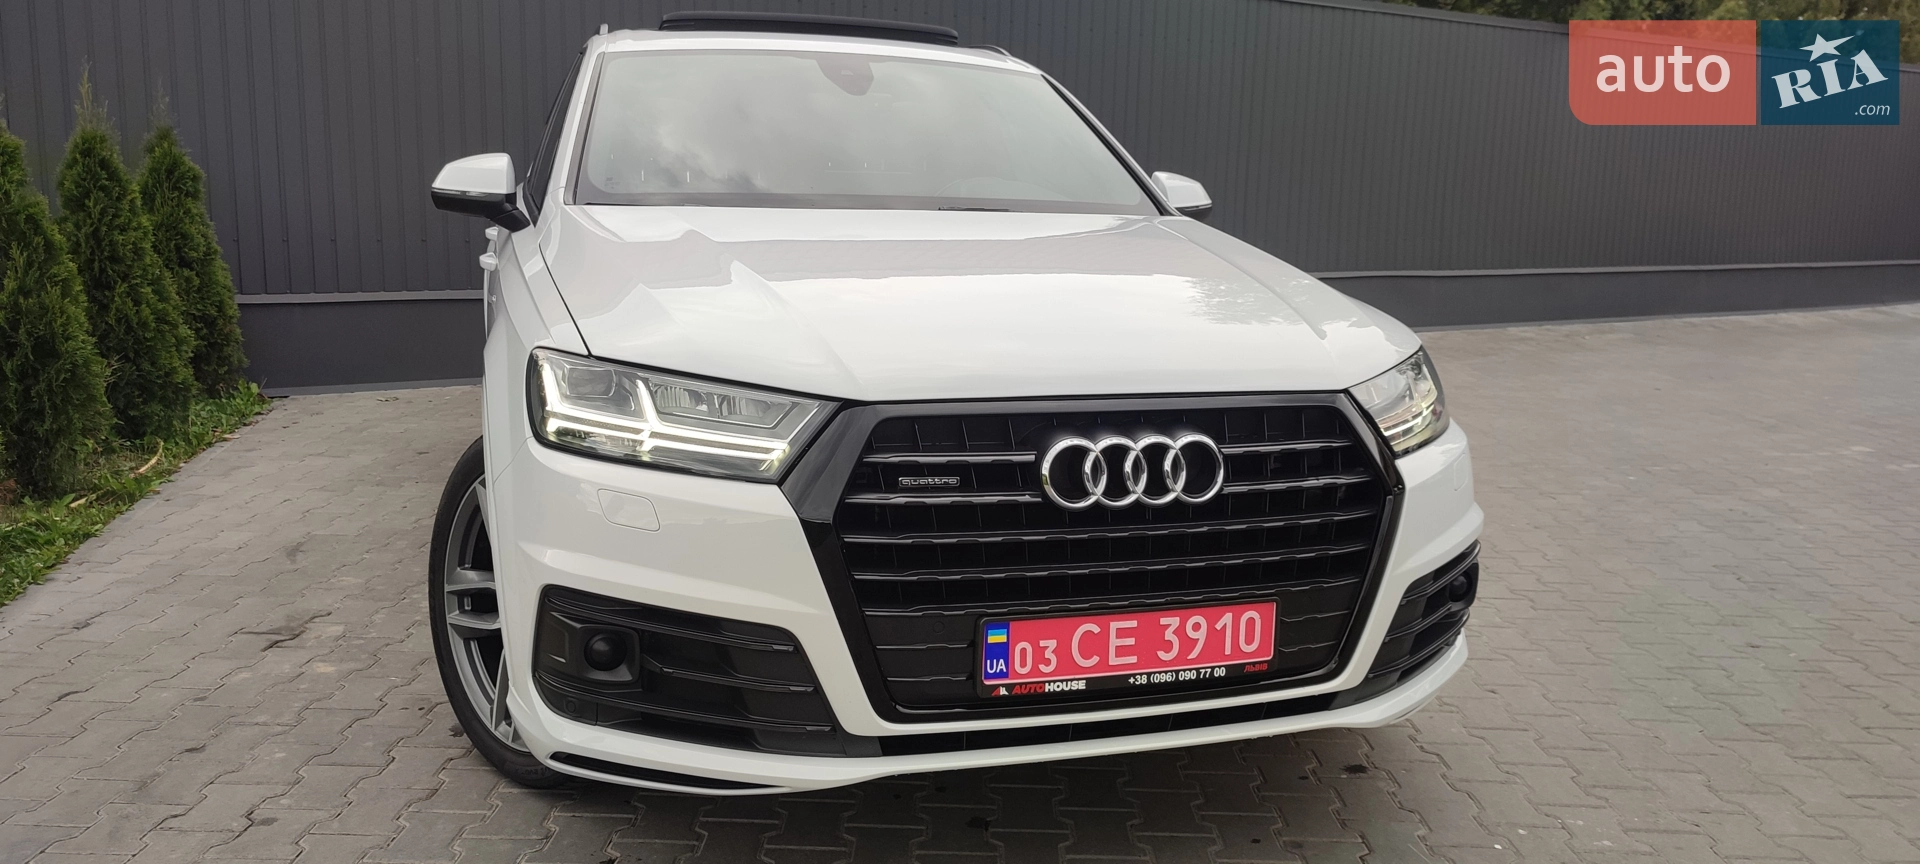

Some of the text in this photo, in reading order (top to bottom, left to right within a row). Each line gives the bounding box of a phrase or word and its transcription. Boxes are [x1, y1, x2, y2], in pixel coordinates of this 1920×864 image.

[901, 478, 958, 486] quattro
[1013, 610, 1262, 675] 03 CE 3910
[986, 658, 1007, 674] UA
[1128, 666, 1226, 686] +38 (096) 090 77 00
[1011, 680, 1087, 695] AUTOHOUSE
